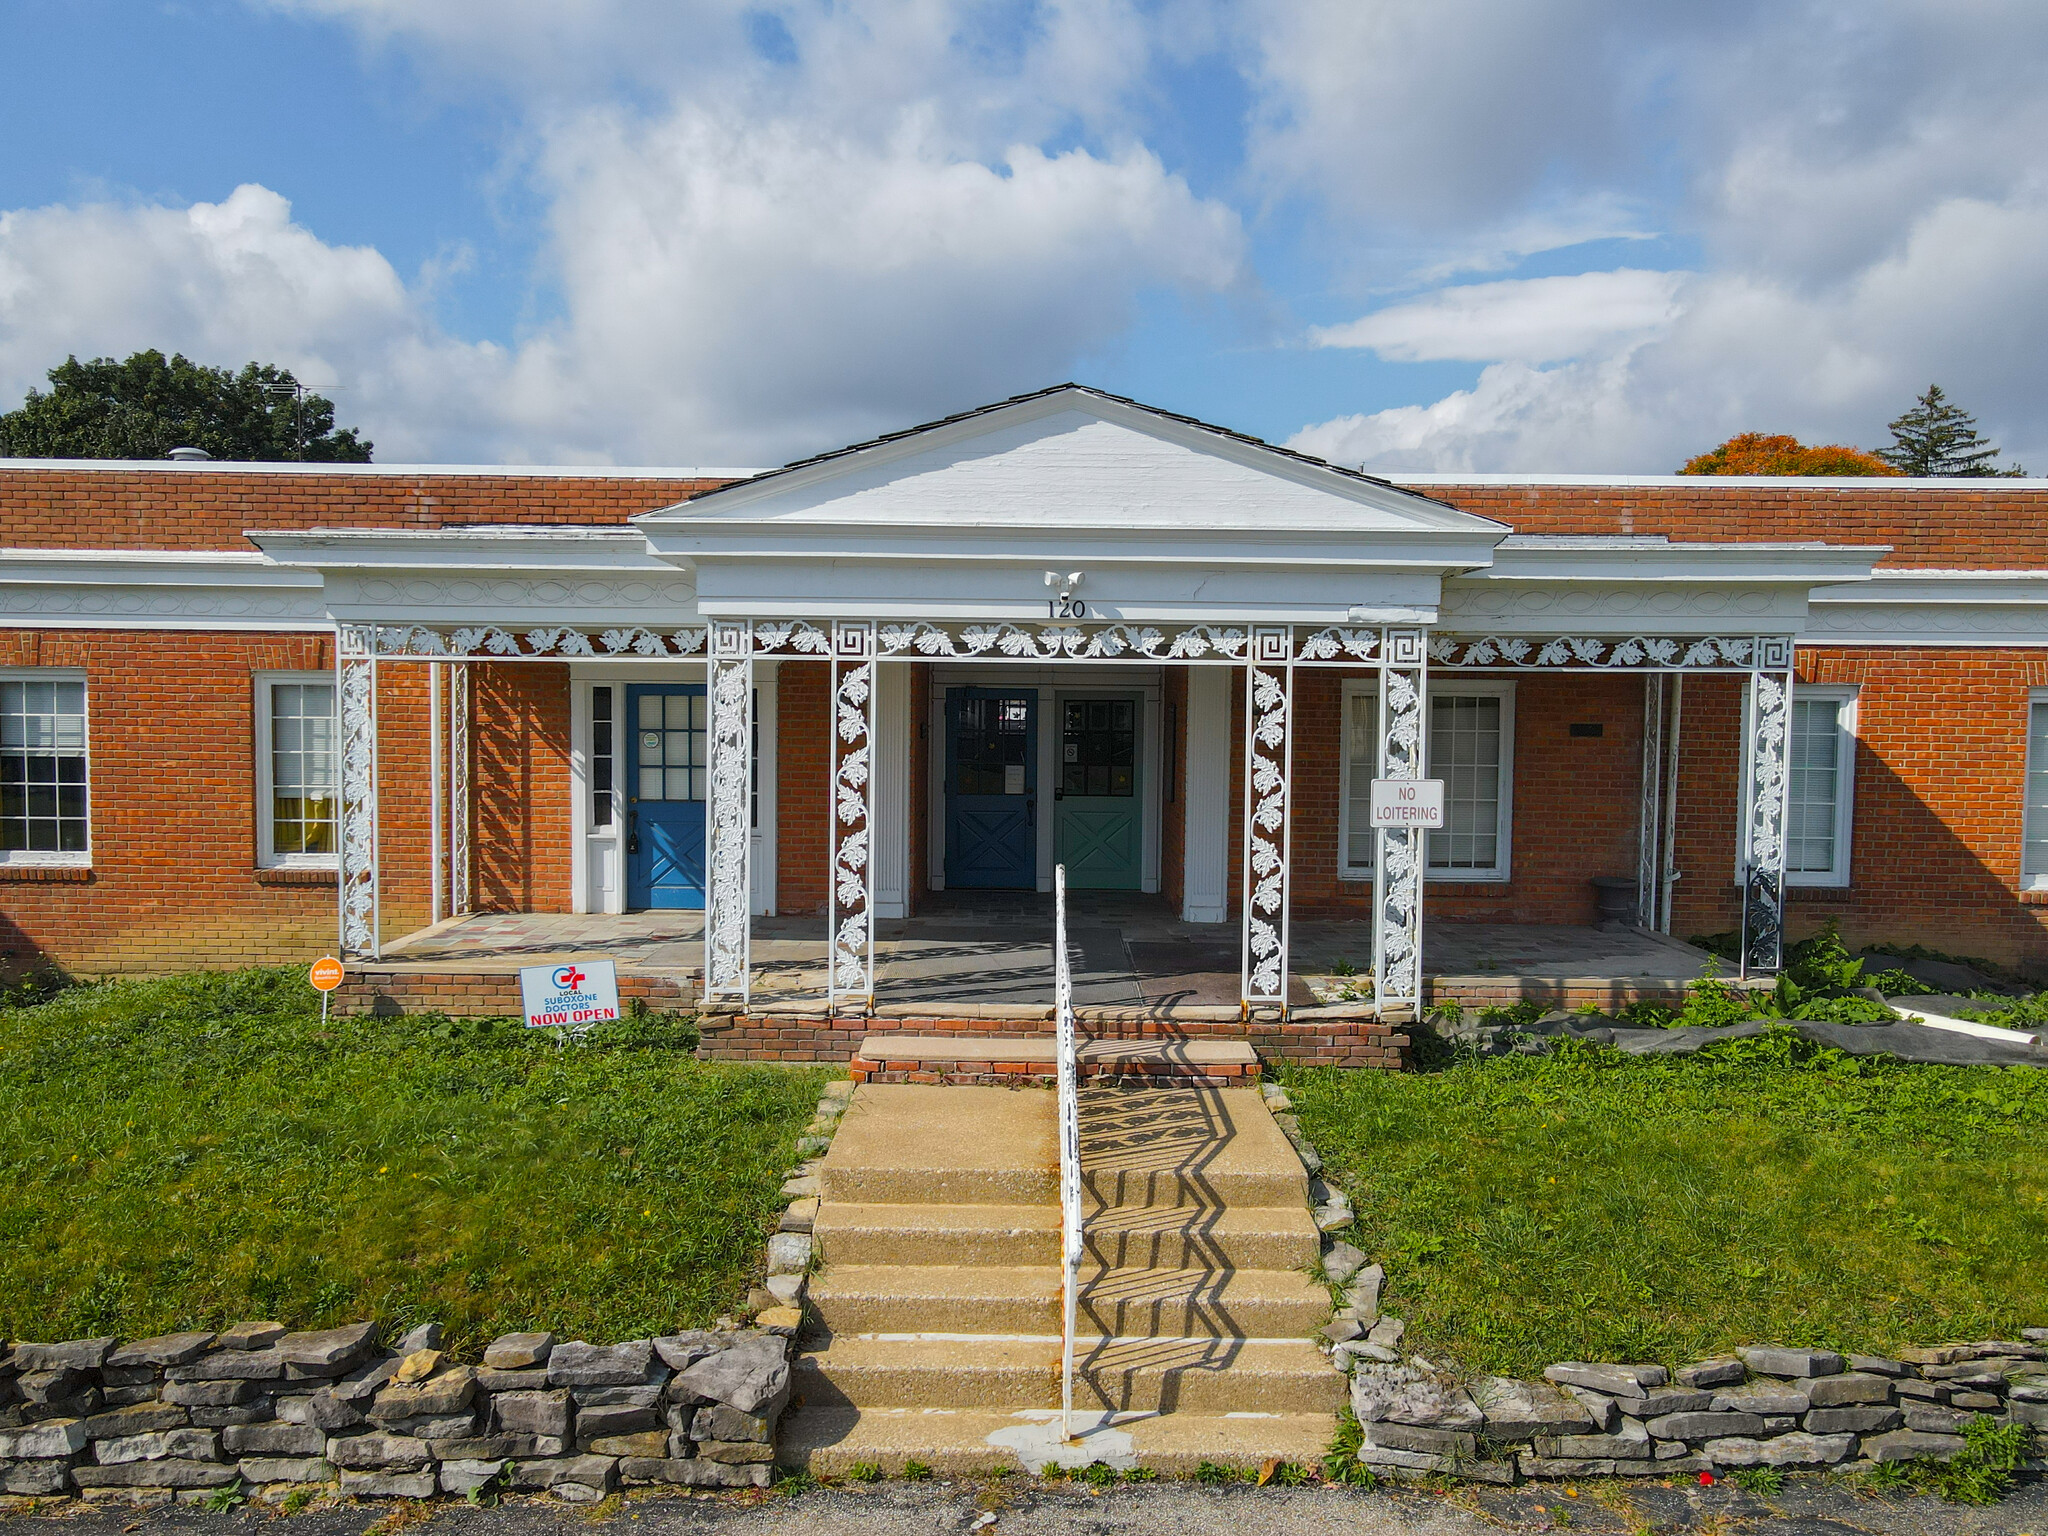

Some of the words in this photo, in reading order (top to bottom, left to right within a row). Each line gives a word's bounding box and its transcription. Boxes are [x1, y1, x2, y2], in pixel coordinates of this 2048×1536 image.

[1049, 600, 1086, 618] 120
[1398, 787, 1416, 801] NO
[1376, 806, 1438, 820] LOITERING
[544, 993, 598, 1006] SUBOXONE
[545, 1002, 590, 1013] DOCTORS
[530, 1012, 568, 1026] NOW
[572, 1008, 615, 1022] OPEN
